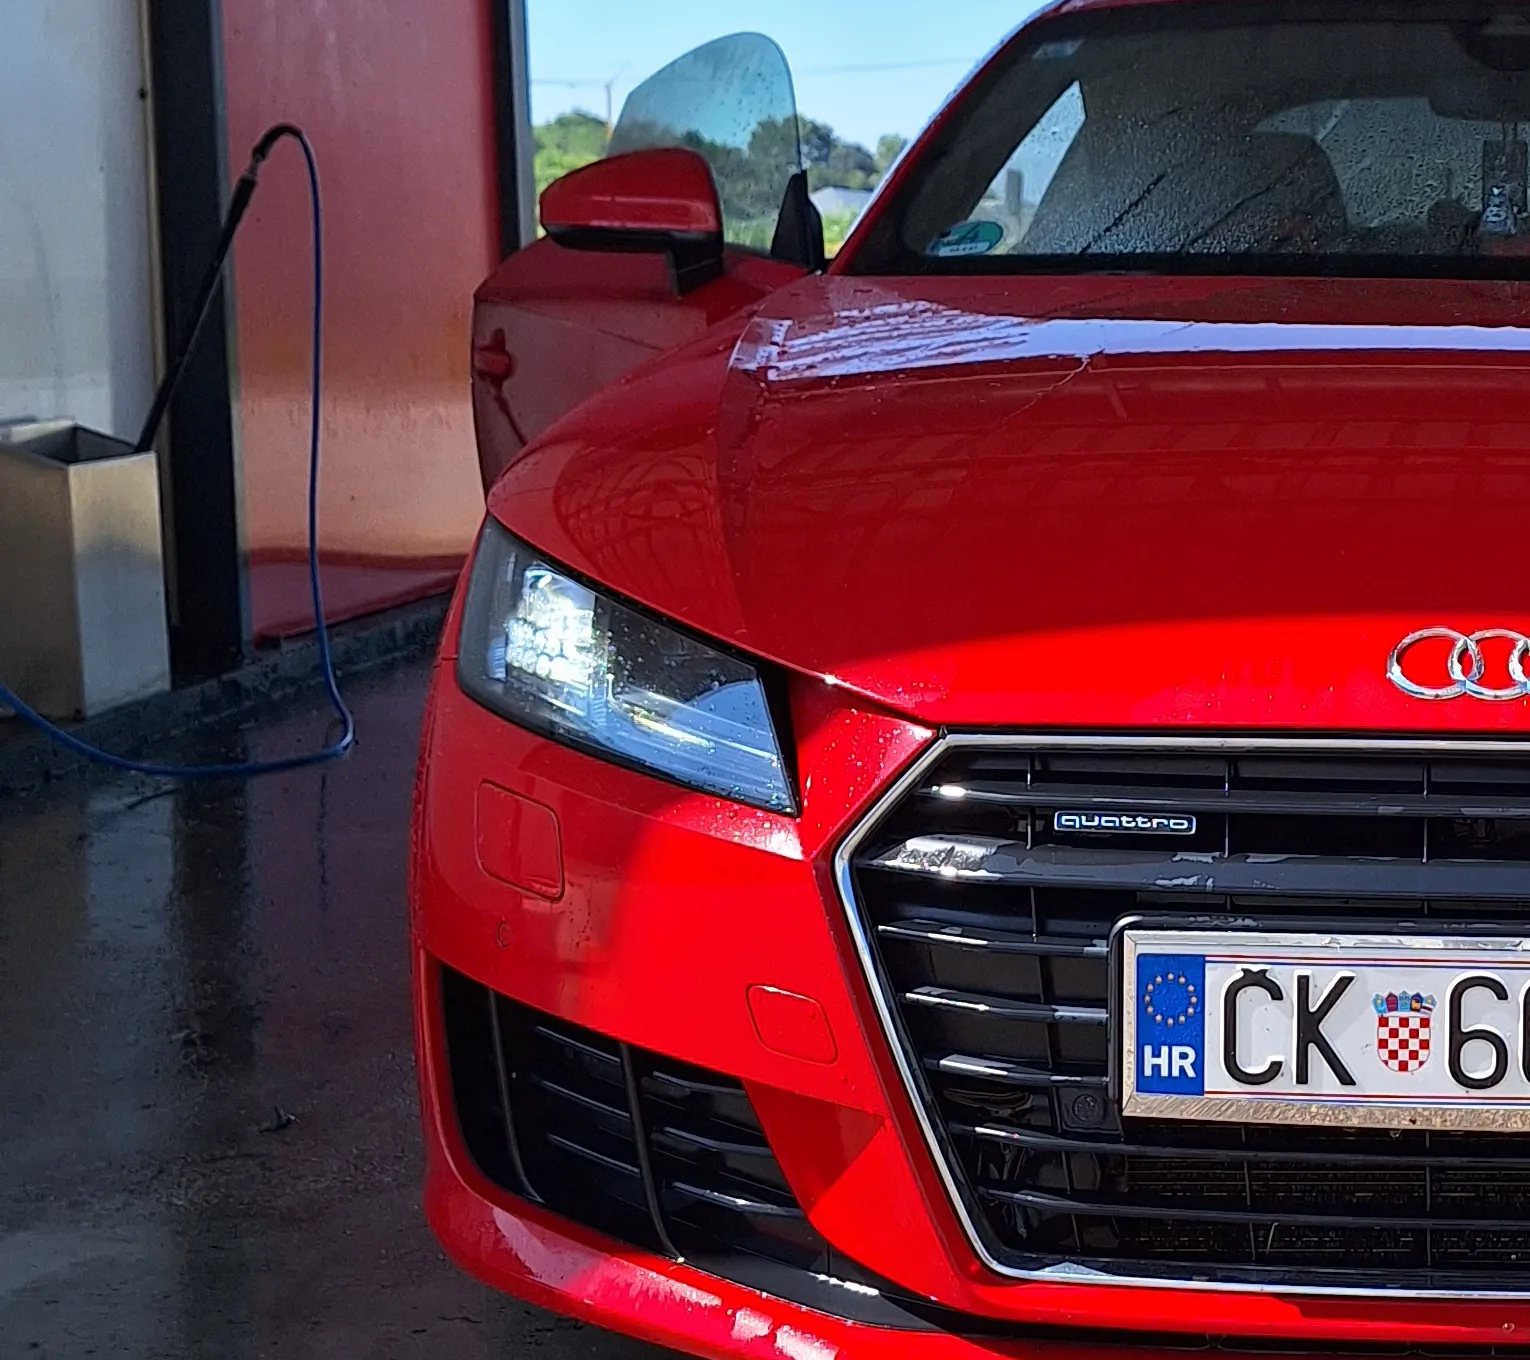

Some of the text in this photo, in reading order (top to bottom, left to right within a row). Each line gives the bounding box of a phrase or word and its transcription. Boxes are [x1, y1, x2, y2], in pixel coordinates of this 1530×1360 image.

[1060, 813, 1189, 831] quattro
[1221, 967, 1357, 1086] ČK
[1143, 1046, 1196, 1078] HR
